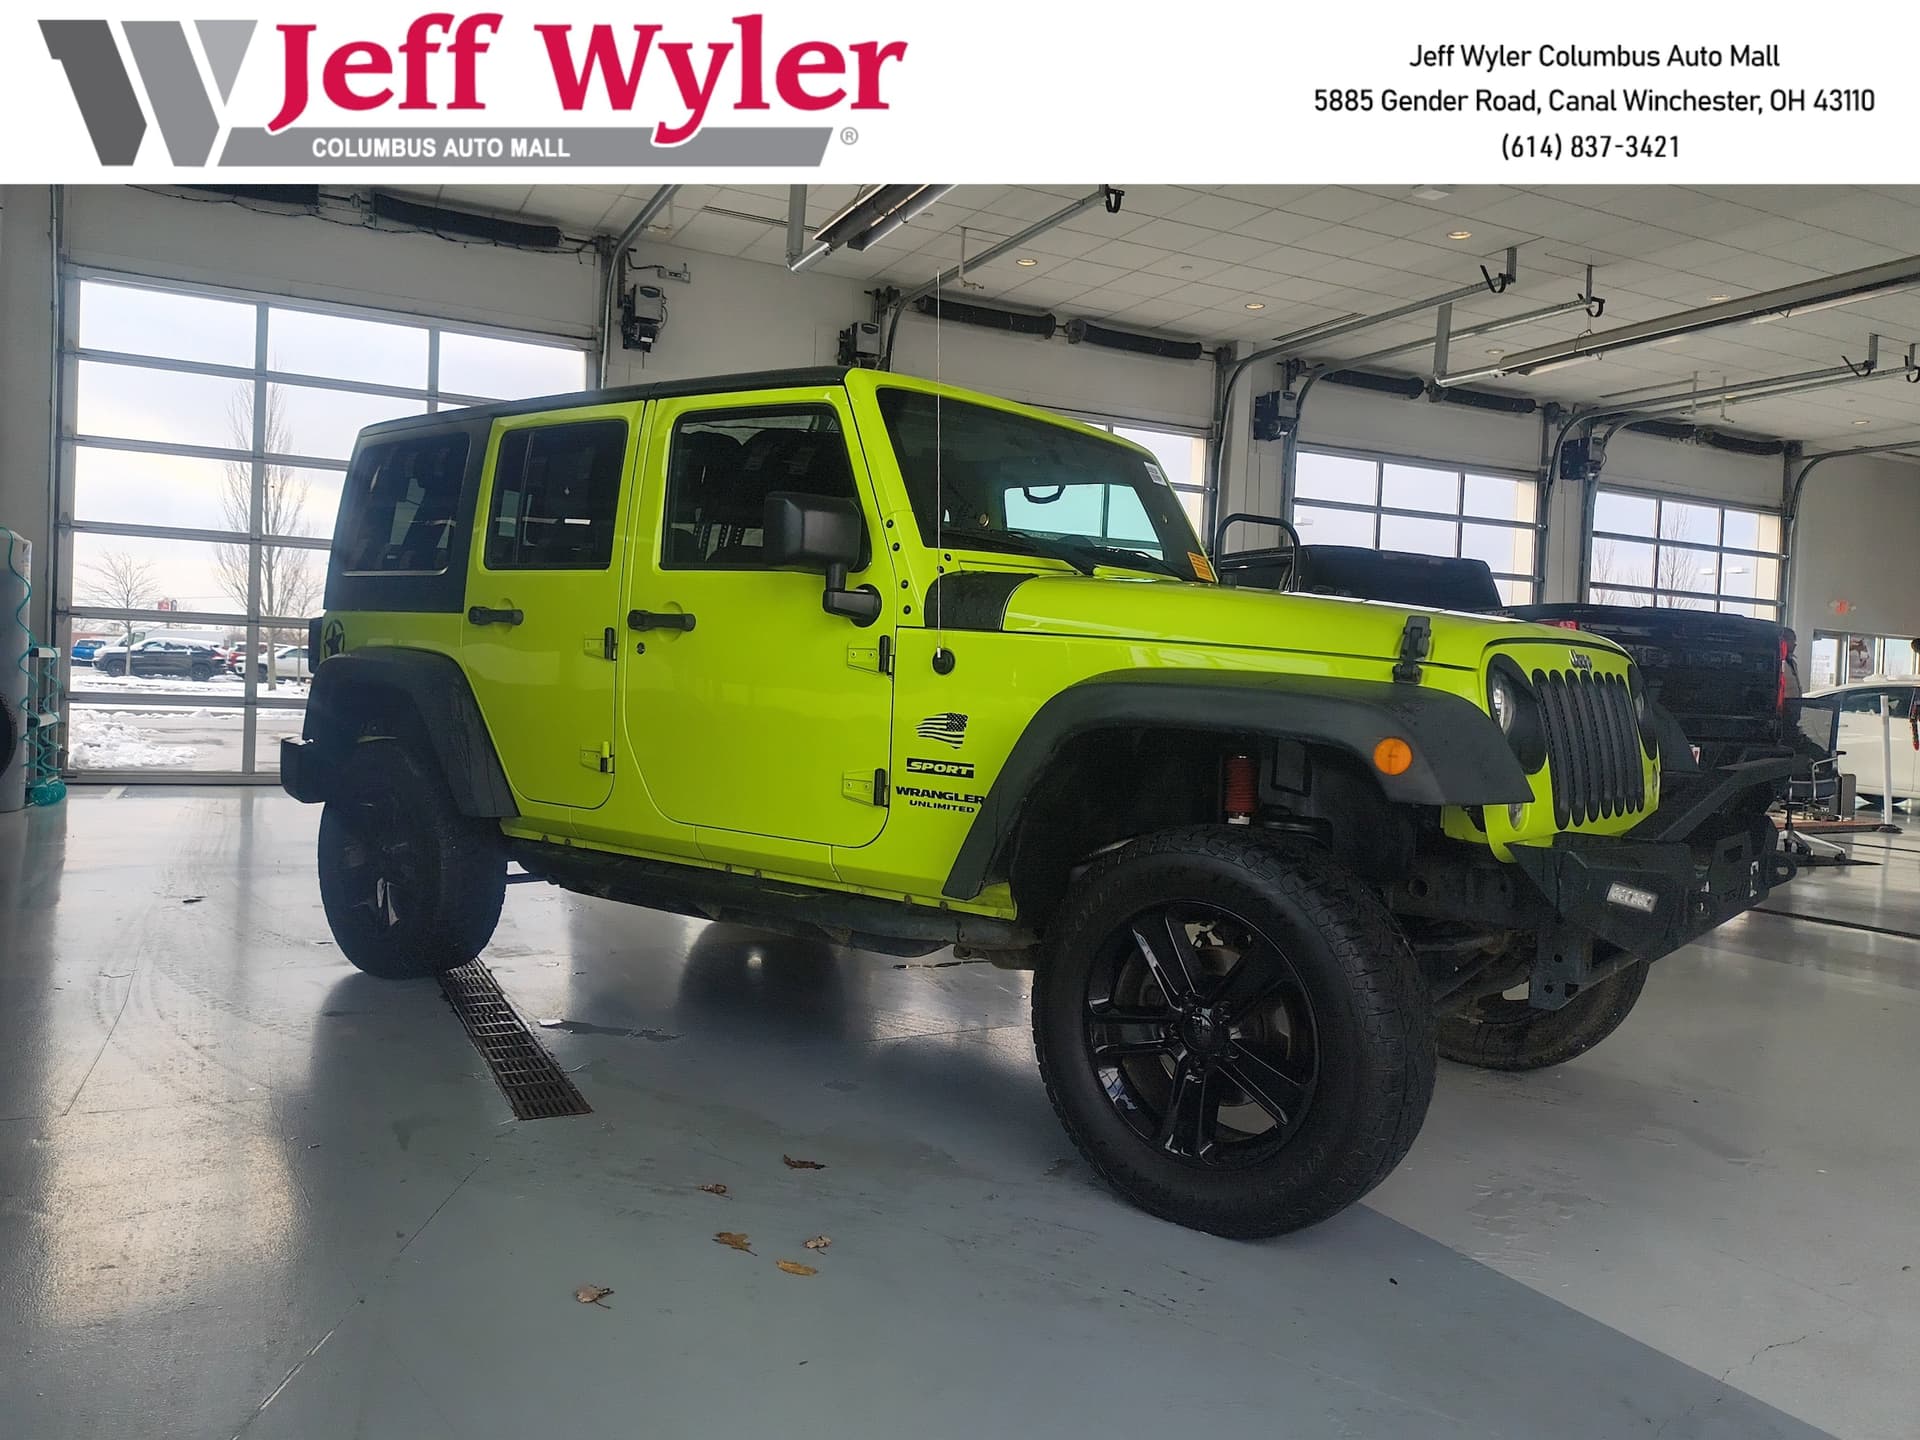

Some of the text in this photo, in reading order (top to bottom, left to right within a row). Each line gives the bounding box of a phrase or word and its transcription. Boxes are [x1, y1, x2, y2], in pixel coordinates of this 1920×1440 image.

[908, 760, 973, 776] SPORT
[895, 785, 986, 804] WRANGLER
[909, 799, 975, 813] UNLIMITED
